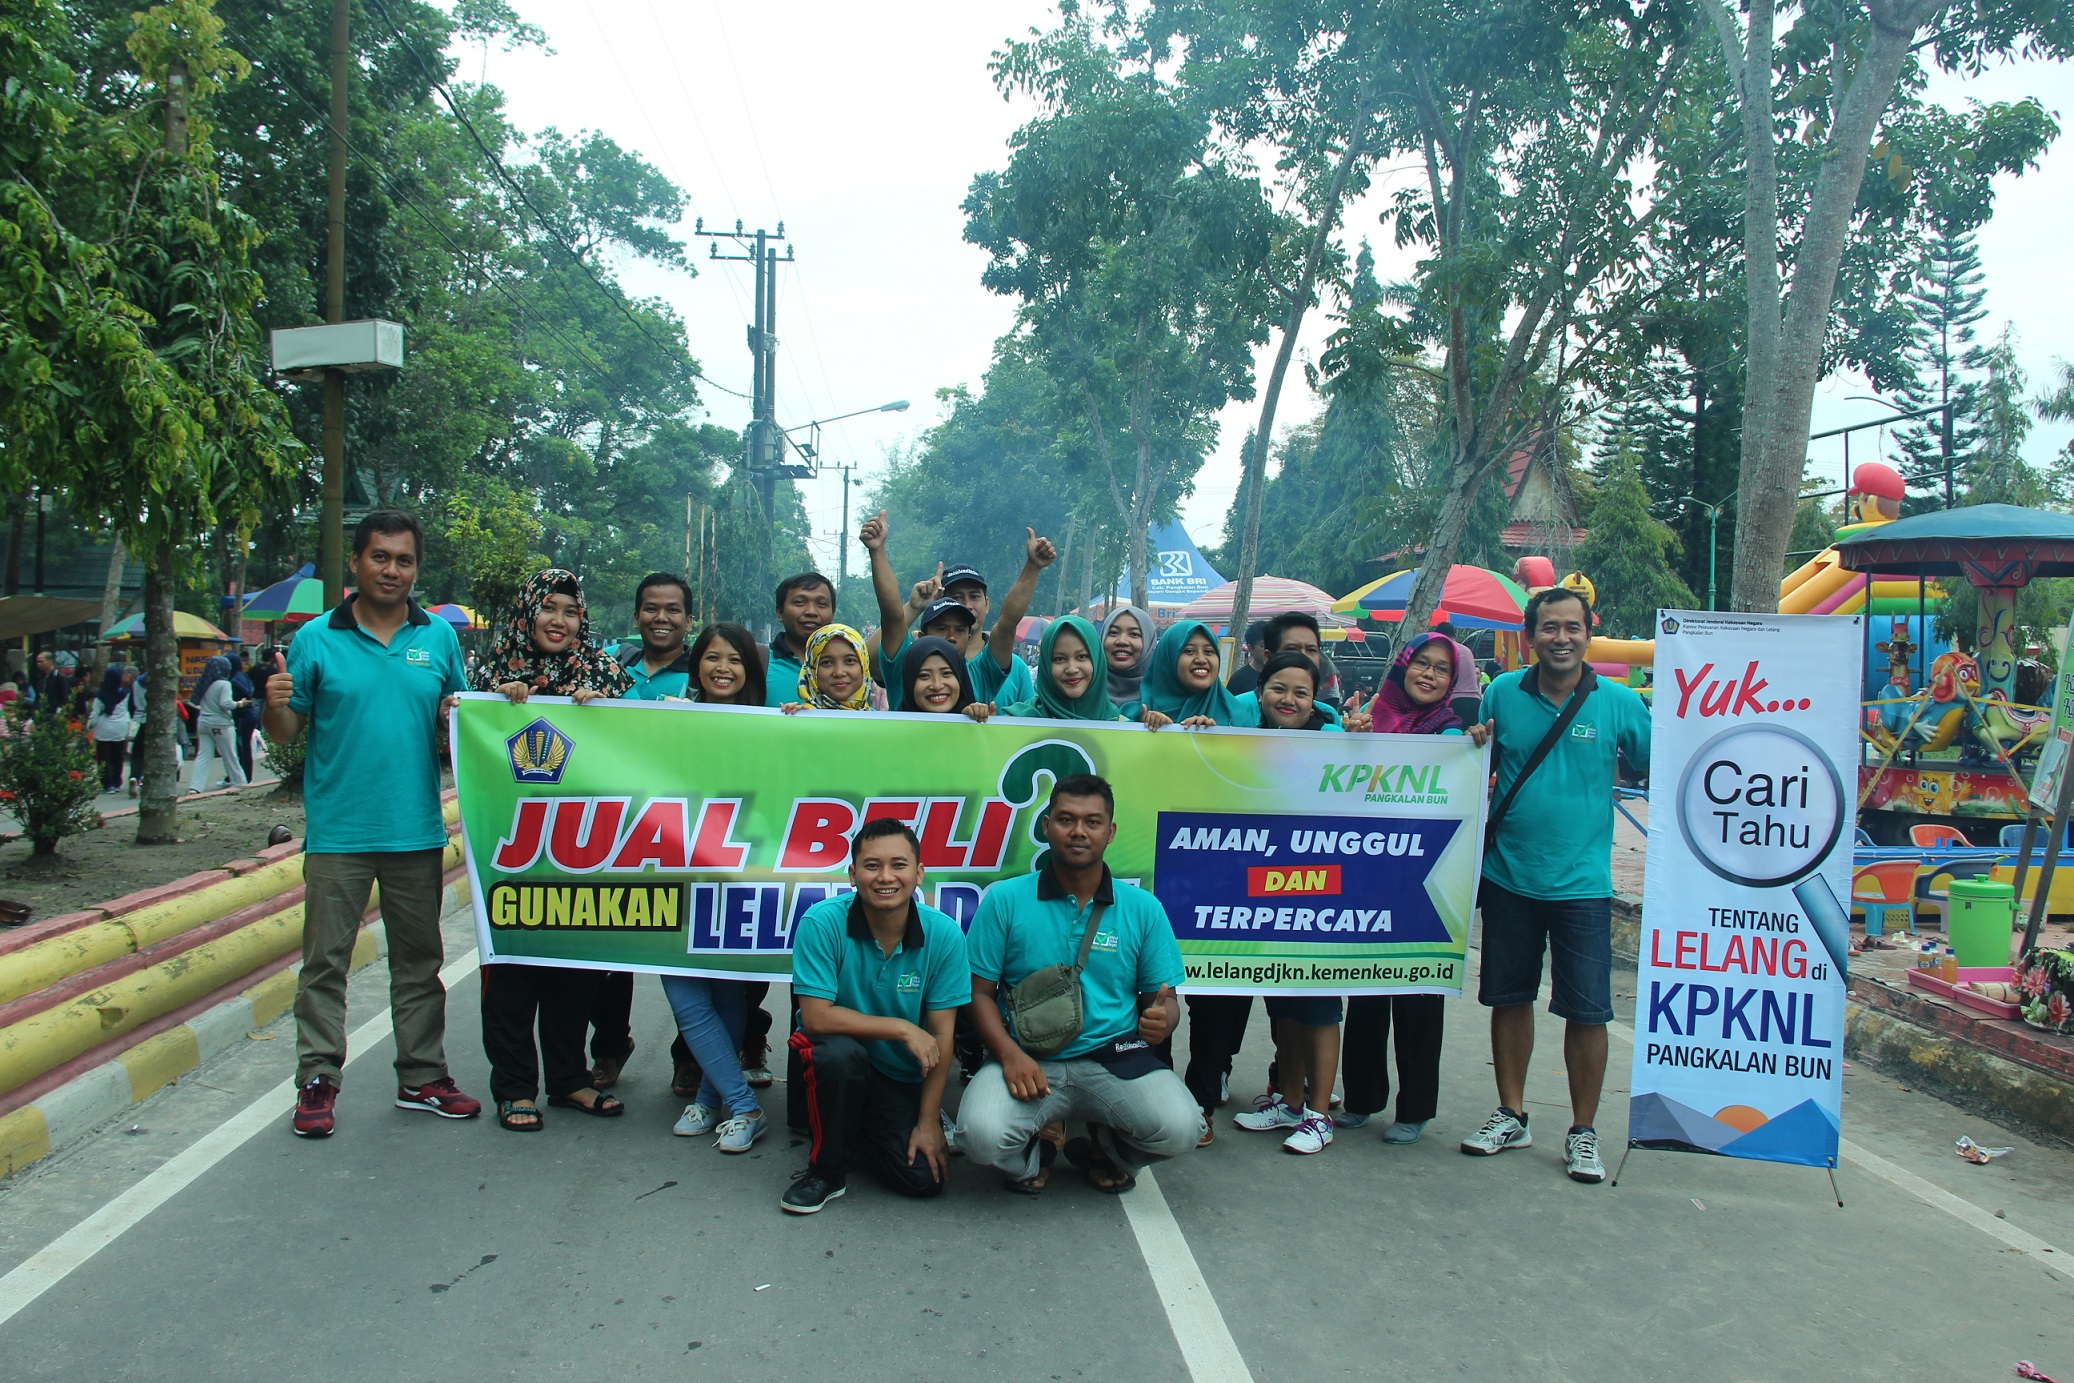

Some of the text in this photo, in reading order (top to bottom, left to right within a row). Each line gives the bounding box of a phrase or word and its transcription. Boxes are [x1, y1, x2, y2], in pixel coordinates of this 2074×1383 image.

[1151, 576, 1207, 585] BANK BRI
[1674, 660, 1811, 719] Yuk...
[1318, 764, 1448, 794] KPKNL
[1703, 760, 1808, 809] Cari
[1364, 794, 1448, 804] PANGKALAN BUN
[490, 796, 752, 873] JUAL
[1169, 827, 1425, 857] AMAN, UNGGUL
[1712, 811, 1810, 849] Tahu
[1264, 870, 1327, 892] DAN
[491, 885, 679, 927] GUNAKAN
[1194, 905, 1392, 932] TERPERCAYA
[1708, 907, 1799, 934] TENTANG
[1651, 929, 1827, 981] LELANG di
[1648, 981, 1832, 1049] KPKNL
[1647, 1043, 1832, 1080] PANGKALAN BUN
